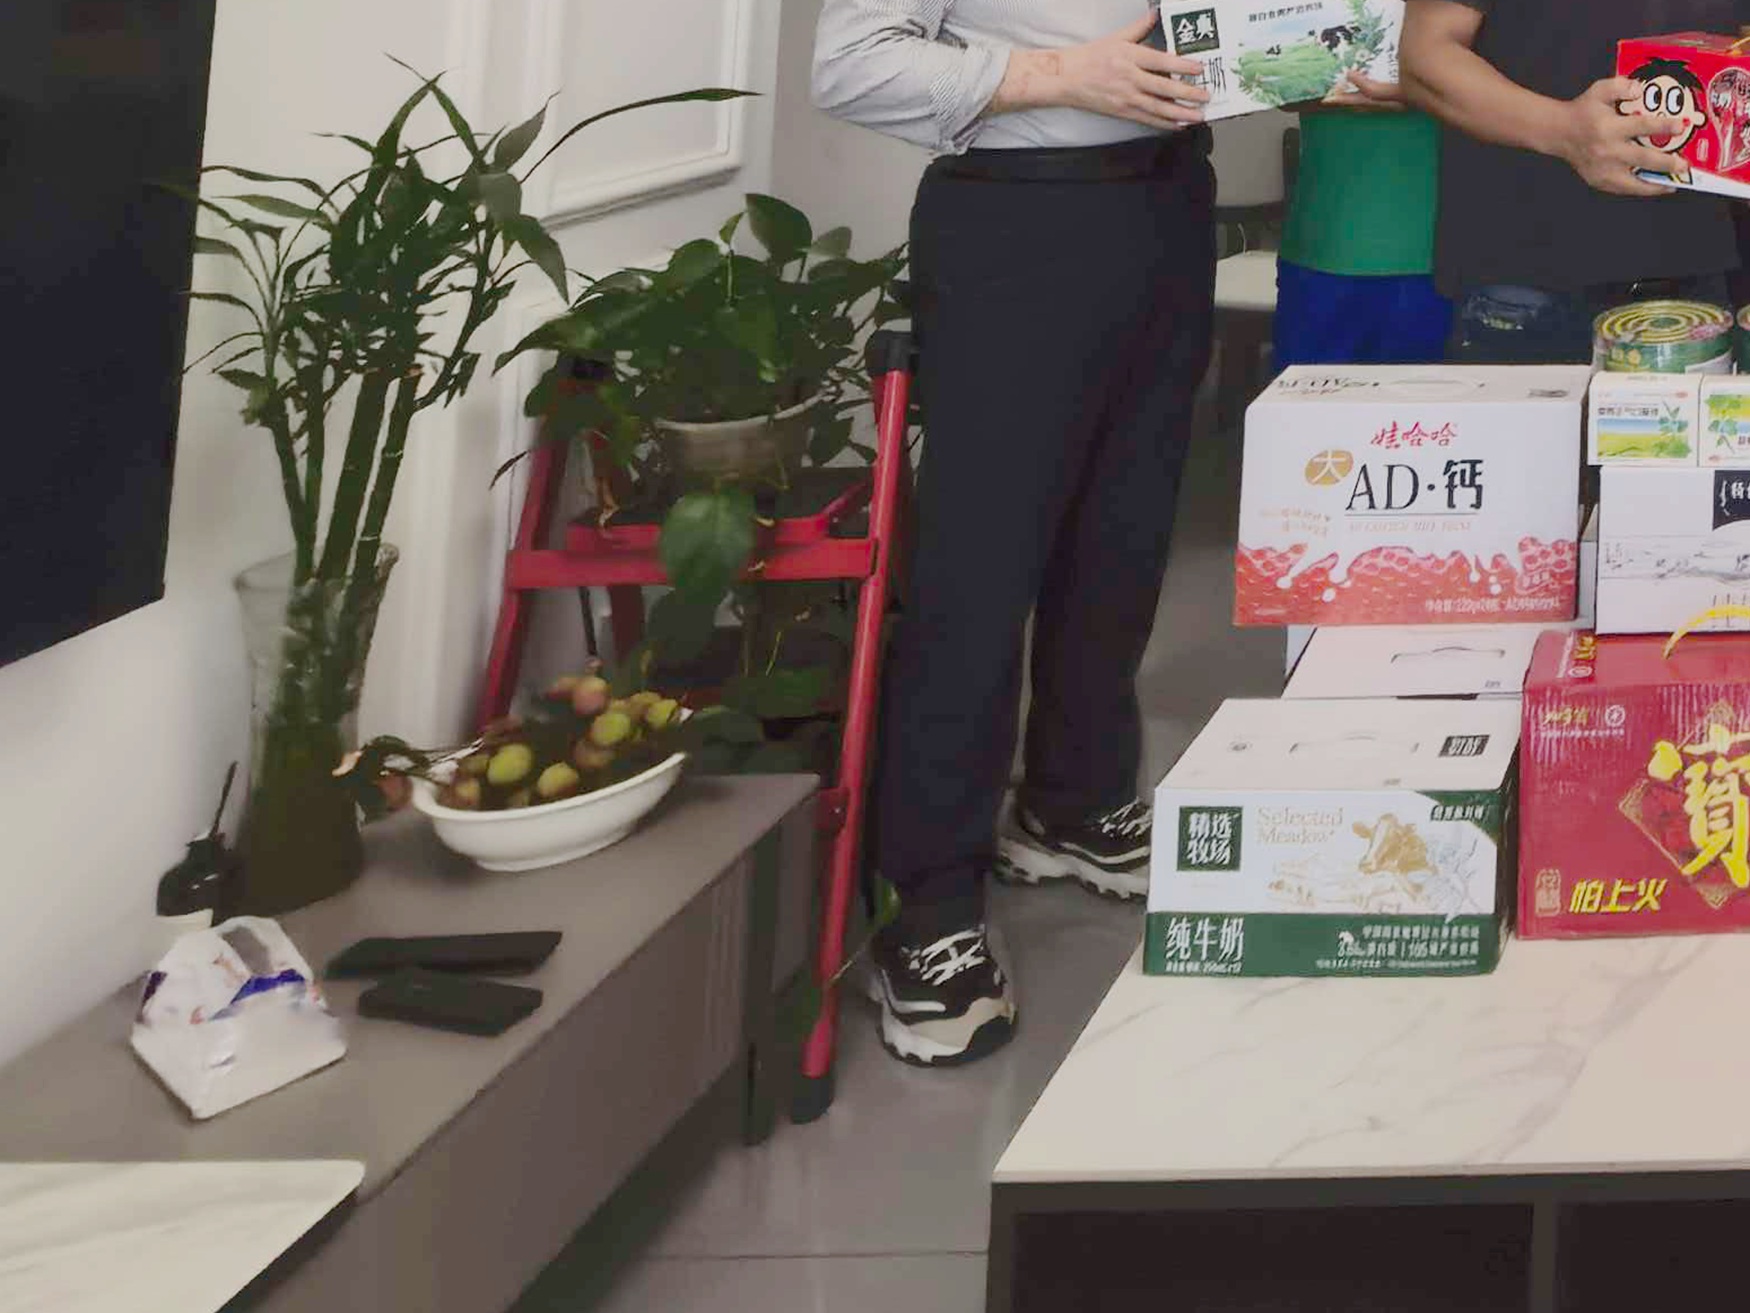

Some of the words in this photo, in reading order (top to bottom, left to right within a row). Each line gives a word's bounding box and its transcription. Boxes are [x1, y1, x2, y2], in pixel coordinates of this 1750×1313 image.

[1175, 12, 1216, 45] 金典
[1370, 420, 1459, 450] 娃哈哈
[1188, 811, 1235, 840] 精选
[1187, 840, 1233, 867] 牧场
[1569, 878, 1669, 914] 怕上火
[1165, 915, 1245, 963] 纯牛奶
